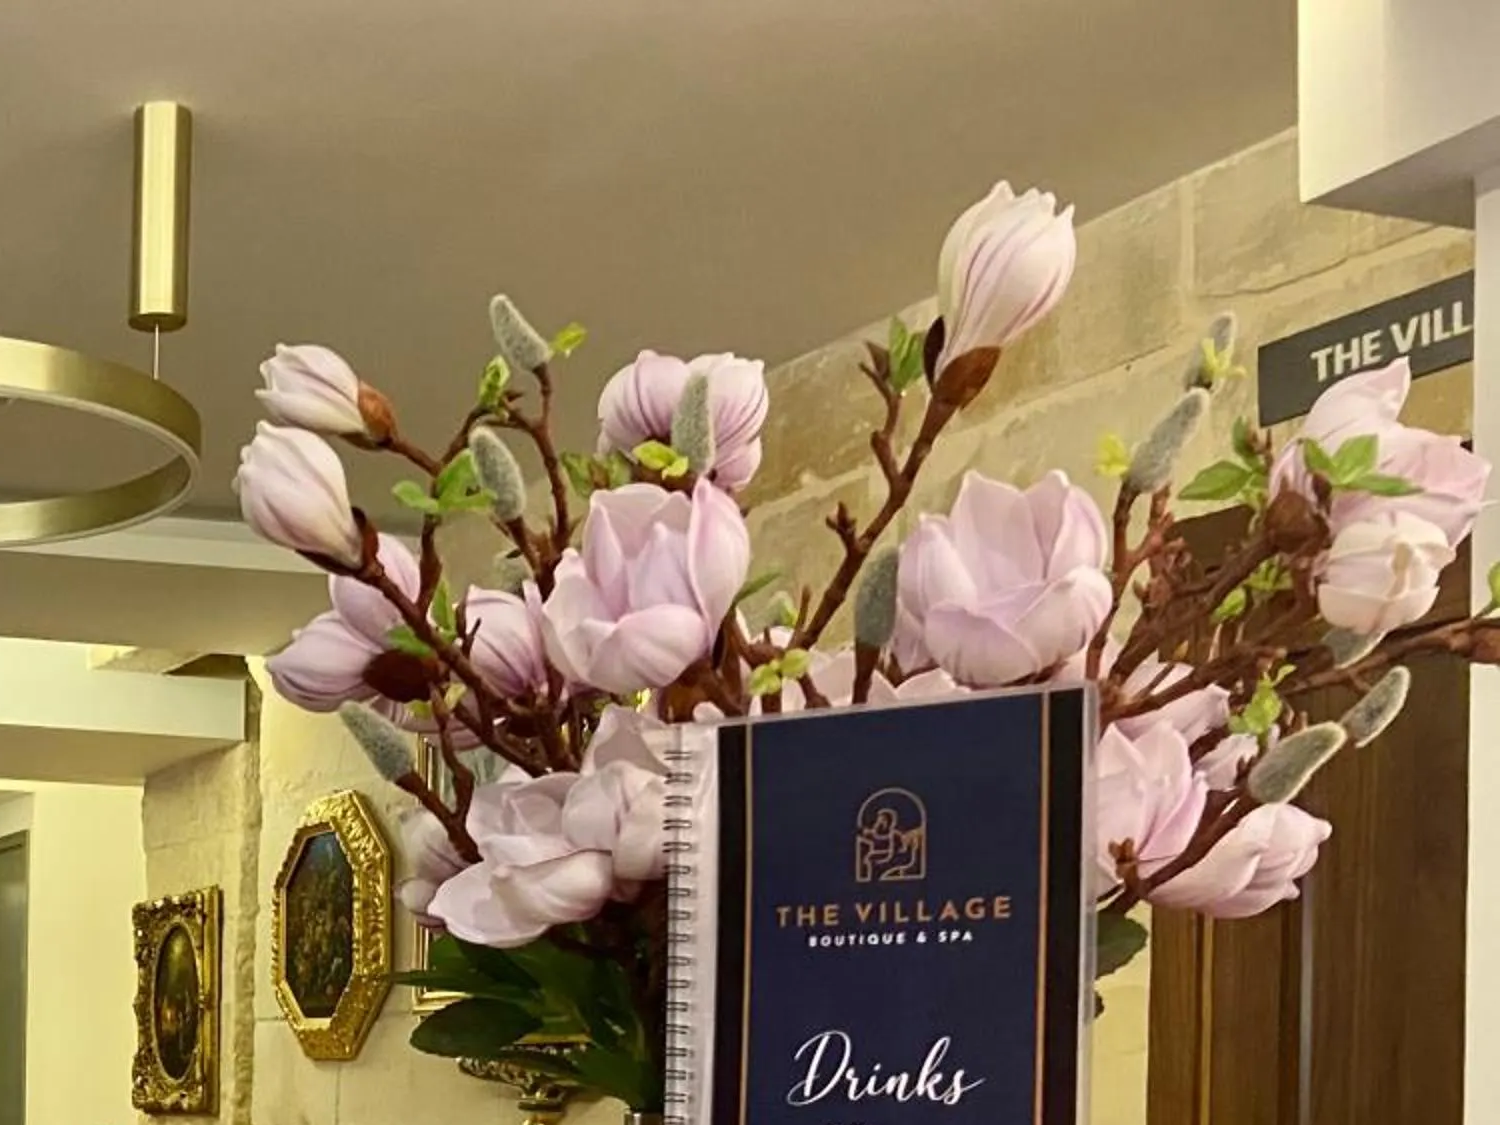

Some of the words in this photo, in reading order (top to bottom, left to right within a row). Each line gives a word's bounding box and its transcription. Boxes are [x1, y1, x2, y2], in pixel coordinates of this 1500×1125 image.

[1309, 328, 1382, 382] THE
[1388, 300, 1474, 354] VILL
[776, 903, 840, 929] THE
[855, 895, 1012, 925] VILLAGE
[808, 931, 907, 947] BOUTIQUE
[916, 930, 927, 943] &
[937, 930, 973, 943] SPA
[787, 1030, 985, 1107] Drinks
